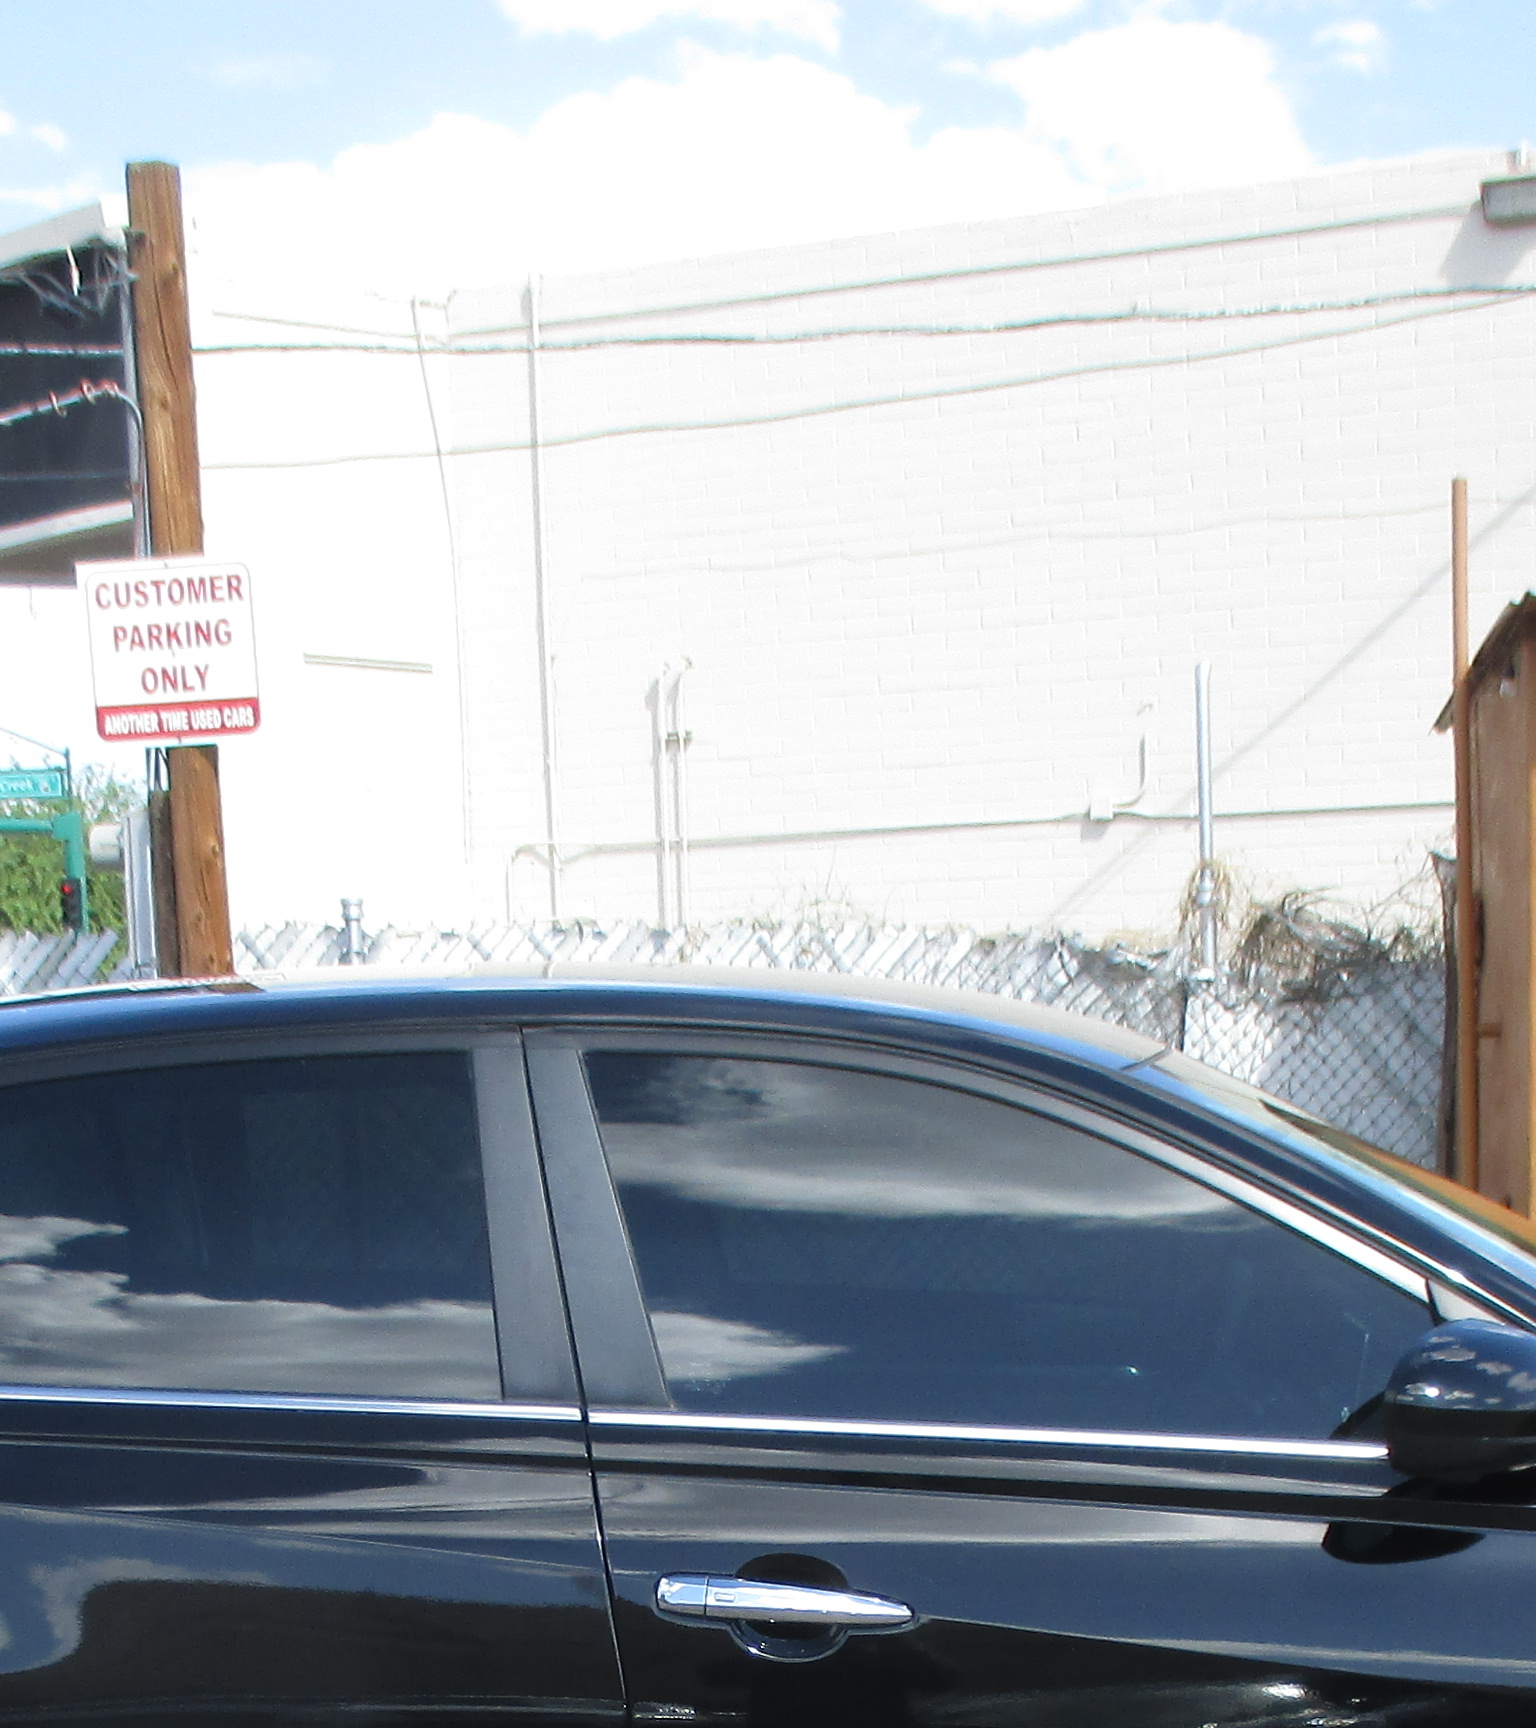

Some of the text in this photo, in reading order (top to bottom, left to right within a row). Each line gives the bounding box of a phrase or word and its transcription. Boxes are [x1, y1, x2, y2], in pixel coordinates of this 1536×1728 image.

[94, 574, 244, 609] CUSTOMER
[112, 618, 232, 652] PARKING
[140, 663, 210, 695] ONLY
[104, 704, 255, 736] ANOTHER TIME USED CARS
